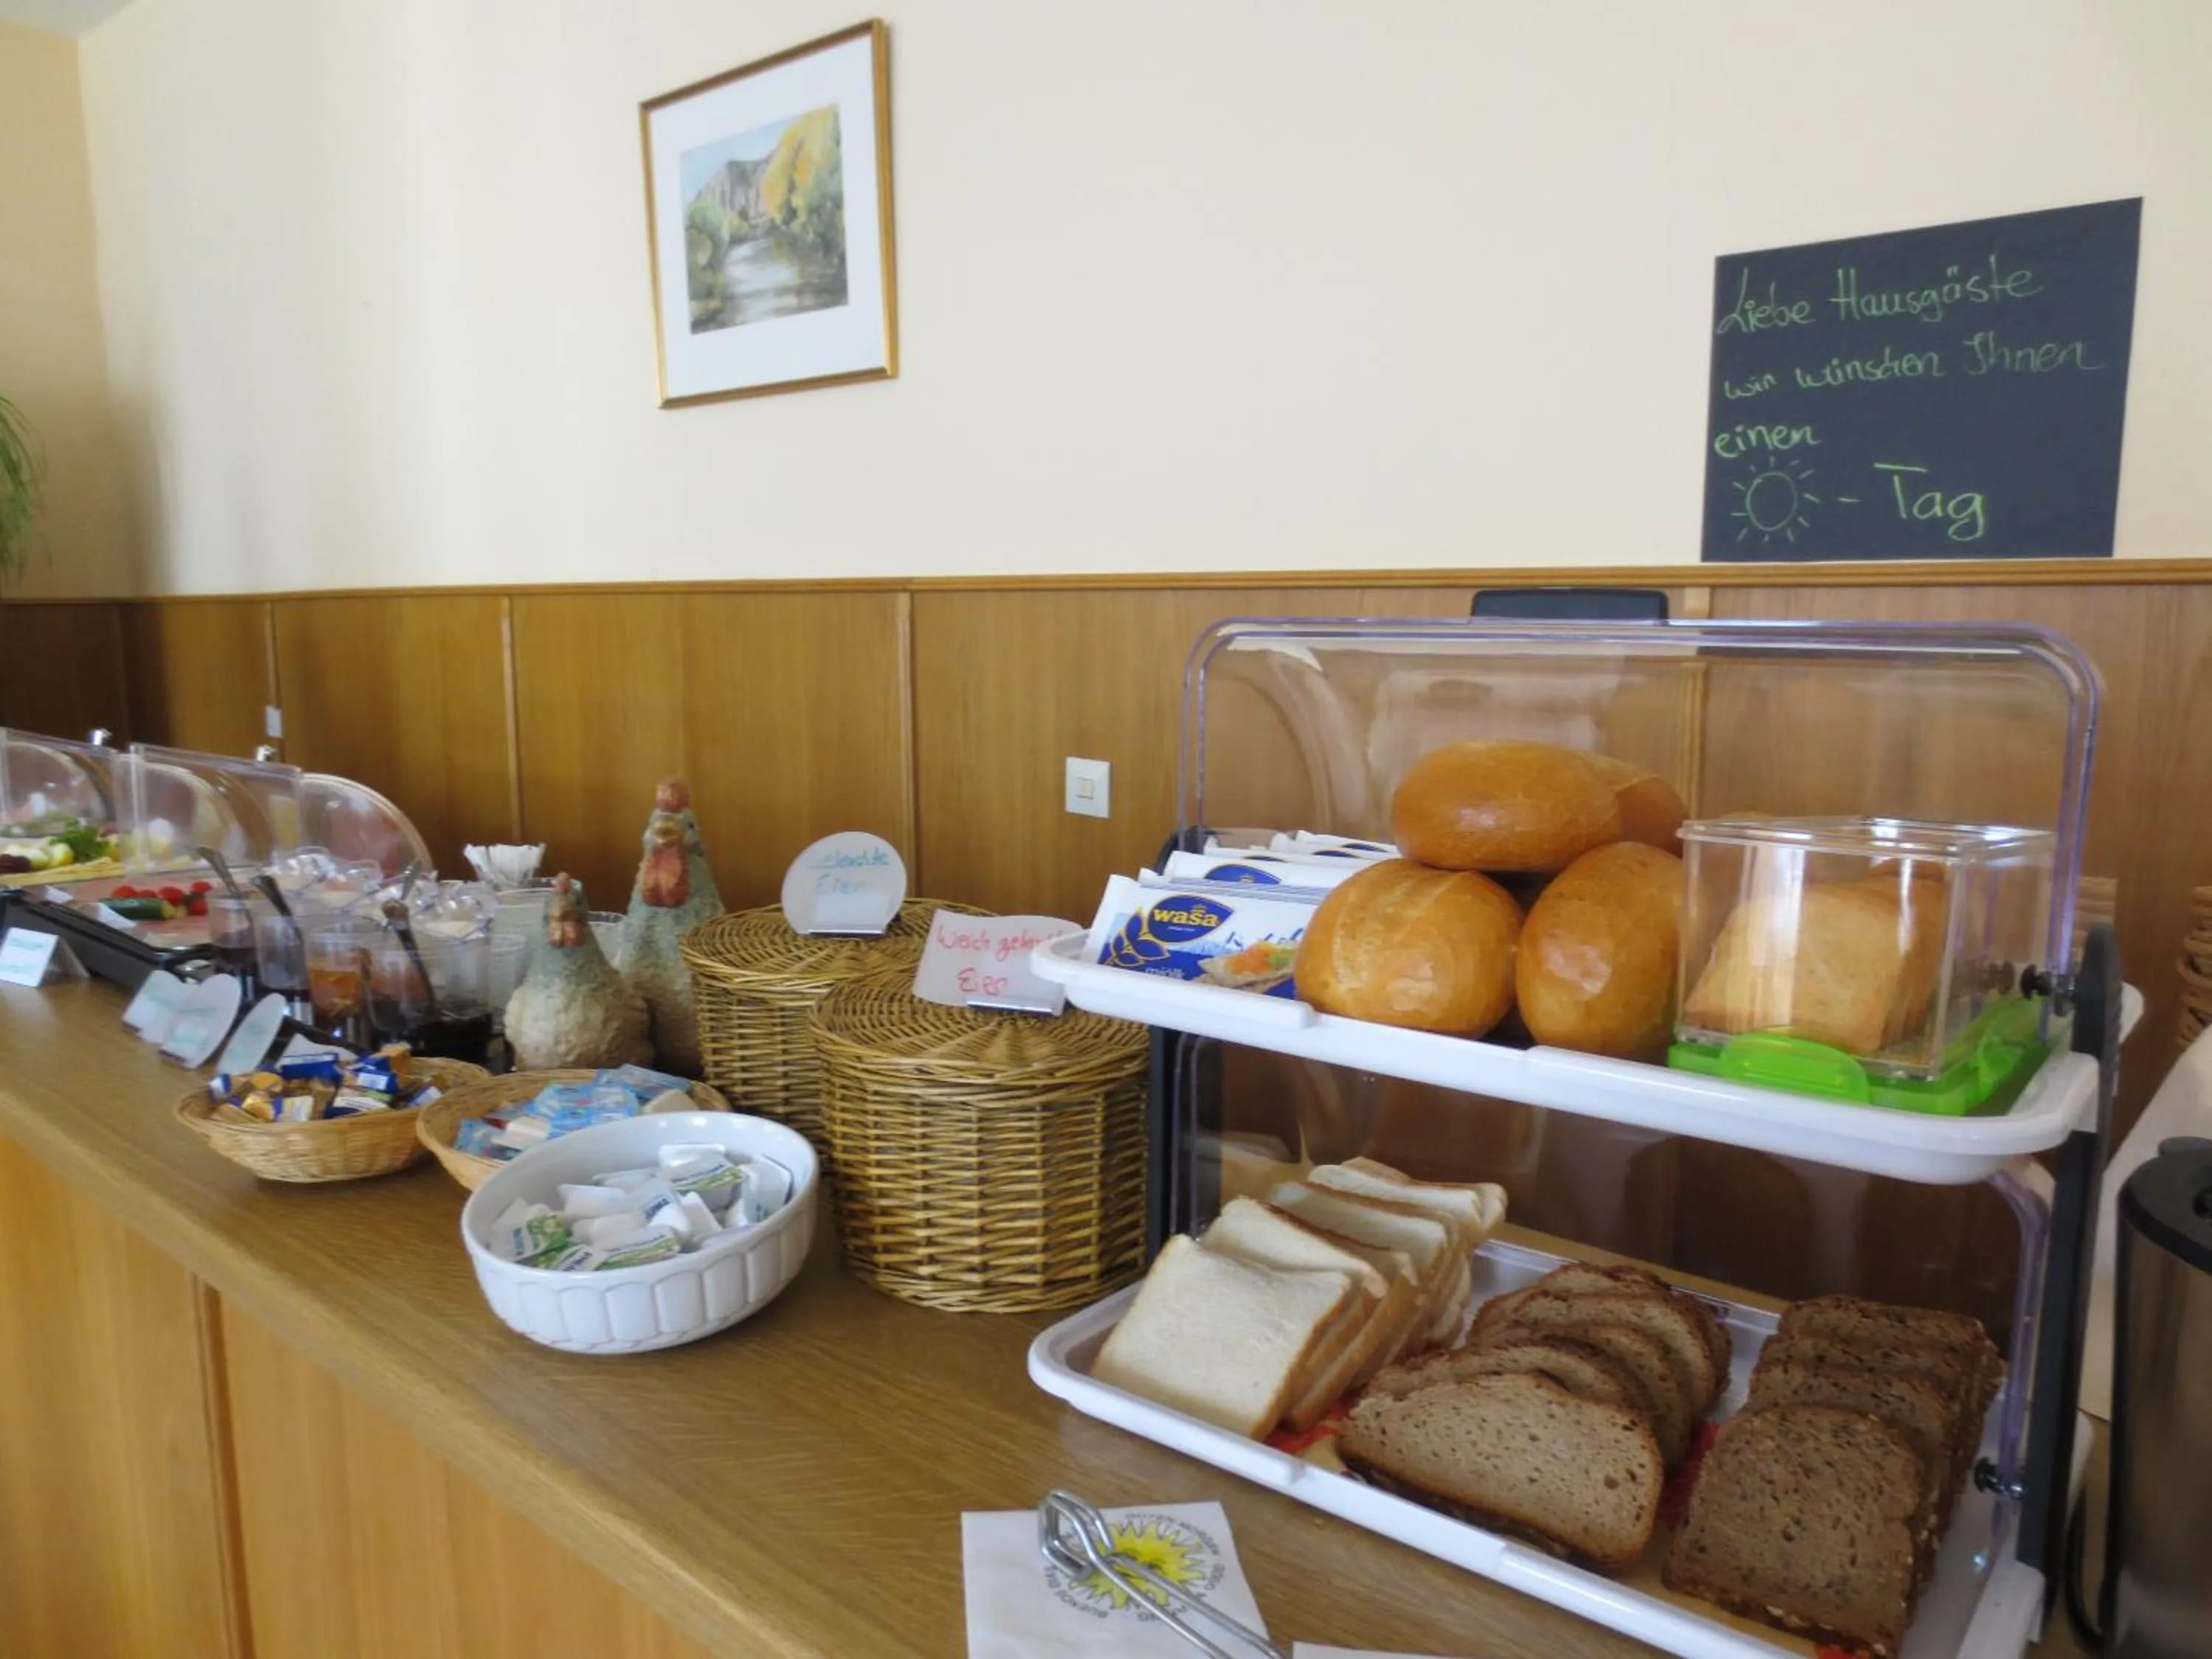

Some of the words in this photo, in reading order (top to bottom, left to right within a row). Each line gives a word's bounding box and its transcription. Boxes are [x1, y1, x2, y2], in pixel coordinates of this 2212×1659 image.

[1716, 267, 1816, 334] Liebe
[1829, 254, 2045, 323] Hausgäste
[1724, 372, 1778, 399] wir
[1963, 330, 2107, 375] Ihnen
[1713, 423, 1820, 459] einen
[1874, 462, 1985, 540] Tag
[1153, 908, 1218, 927] wasa
